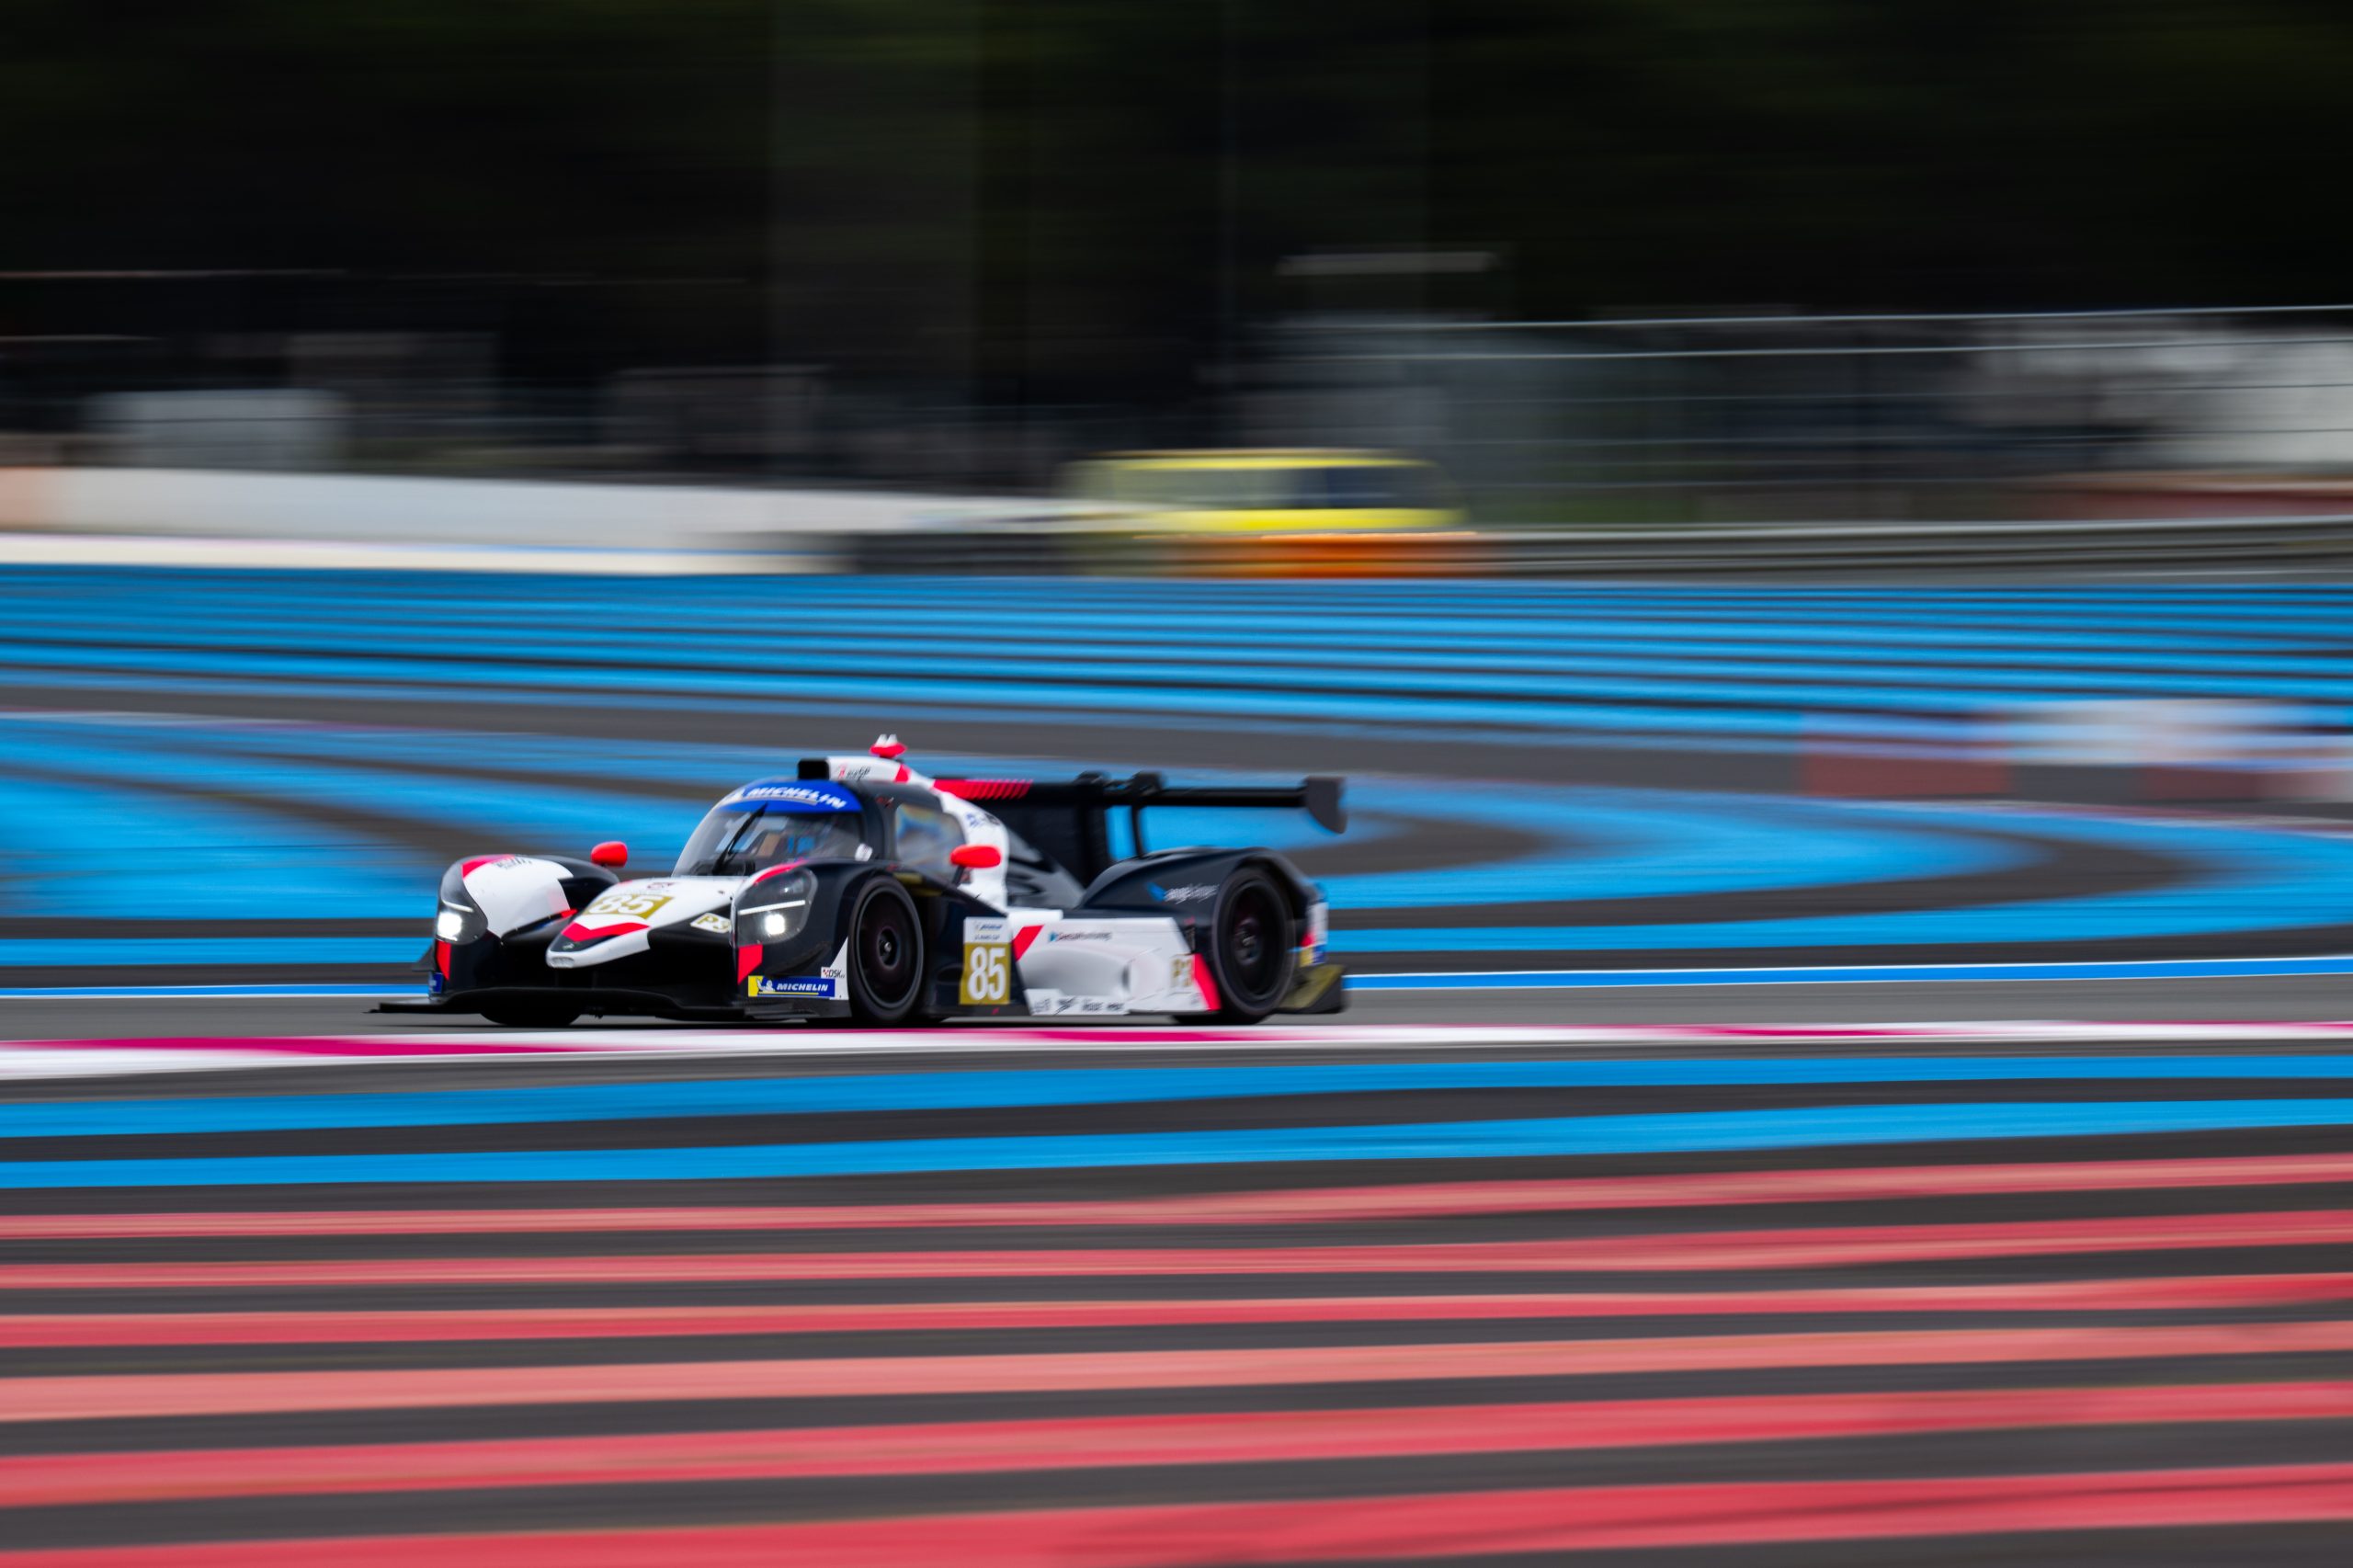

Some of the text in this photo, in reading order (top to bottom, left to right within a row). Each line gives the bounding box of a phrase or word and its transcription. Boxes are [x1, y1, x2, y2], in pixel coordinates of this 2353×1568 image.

[745, 787, 847, 810] MICHELIN
[588, 894, 665, 915] 85
[968, 946, 1006, 1001] 85
[777, 983, 829, 992] MICHELIN
